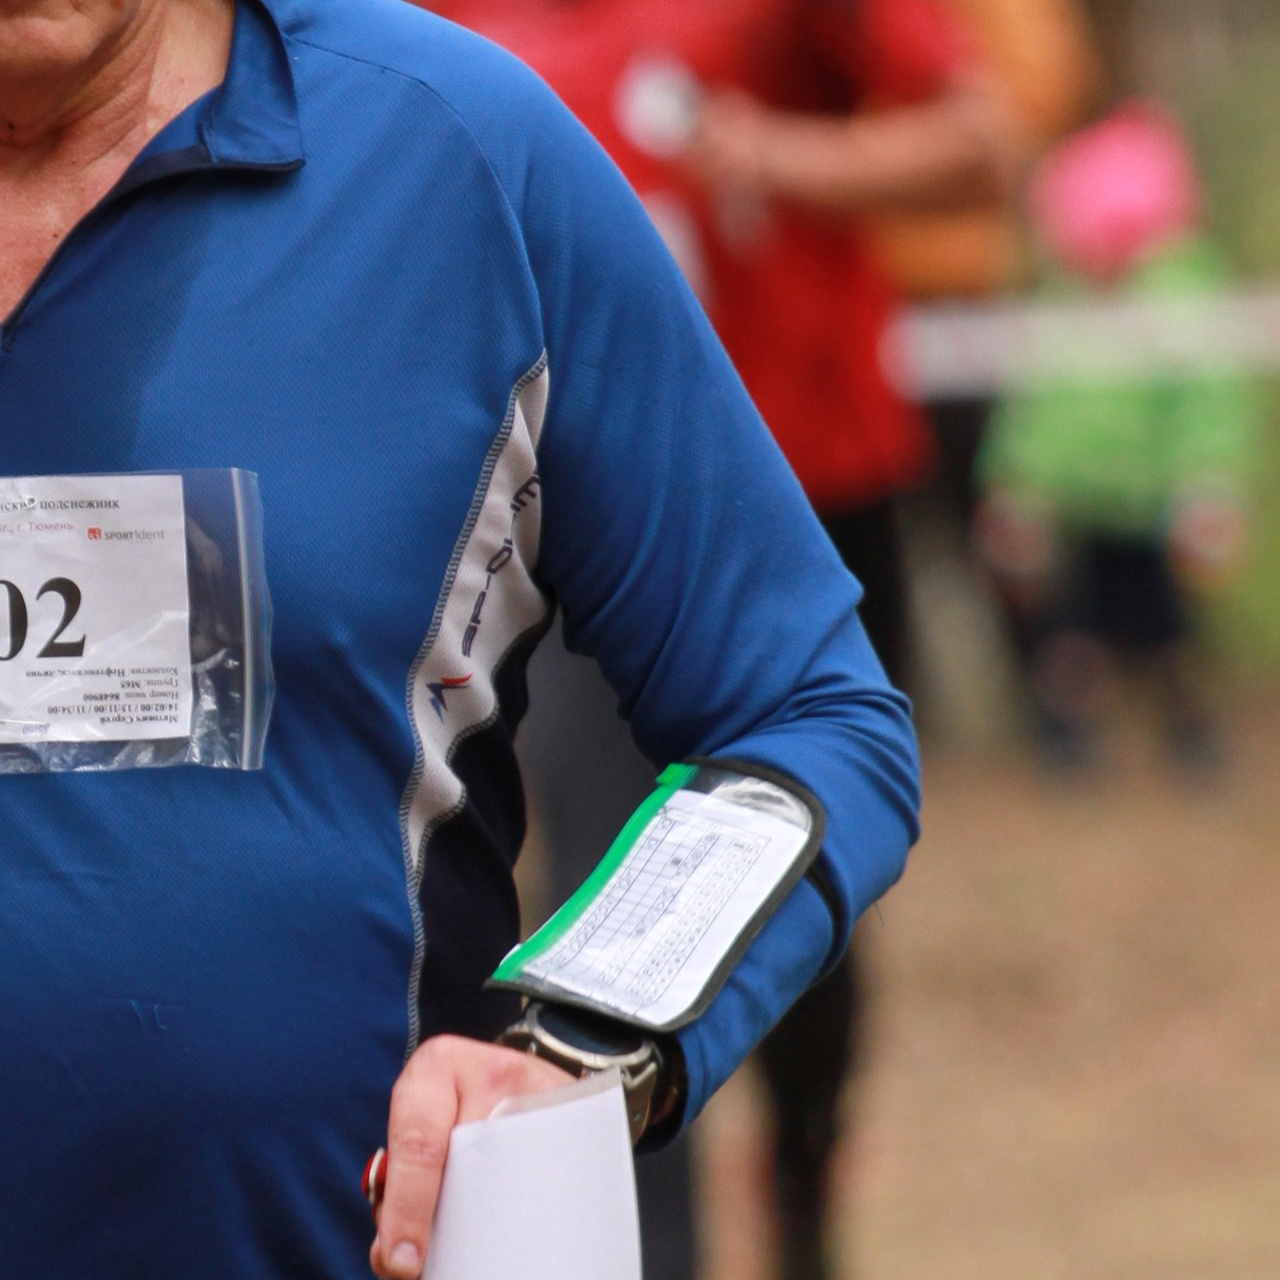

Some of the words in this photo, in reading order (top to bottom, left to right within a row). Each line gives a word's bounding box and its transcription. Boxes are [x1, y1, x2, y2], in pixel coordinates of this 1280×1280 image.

[39, 498, 120, 511] подснежник
[28, 521, 74, 532] Тюмень
[83, 692, 120, 702] 8648900
[47, 705, 85, 714] 11:34:00
[93, 704, 132, 714] 13:11:00
[140, 703, 178, 713] 14:02:00
[100, 714, 133, 725] Сергей
